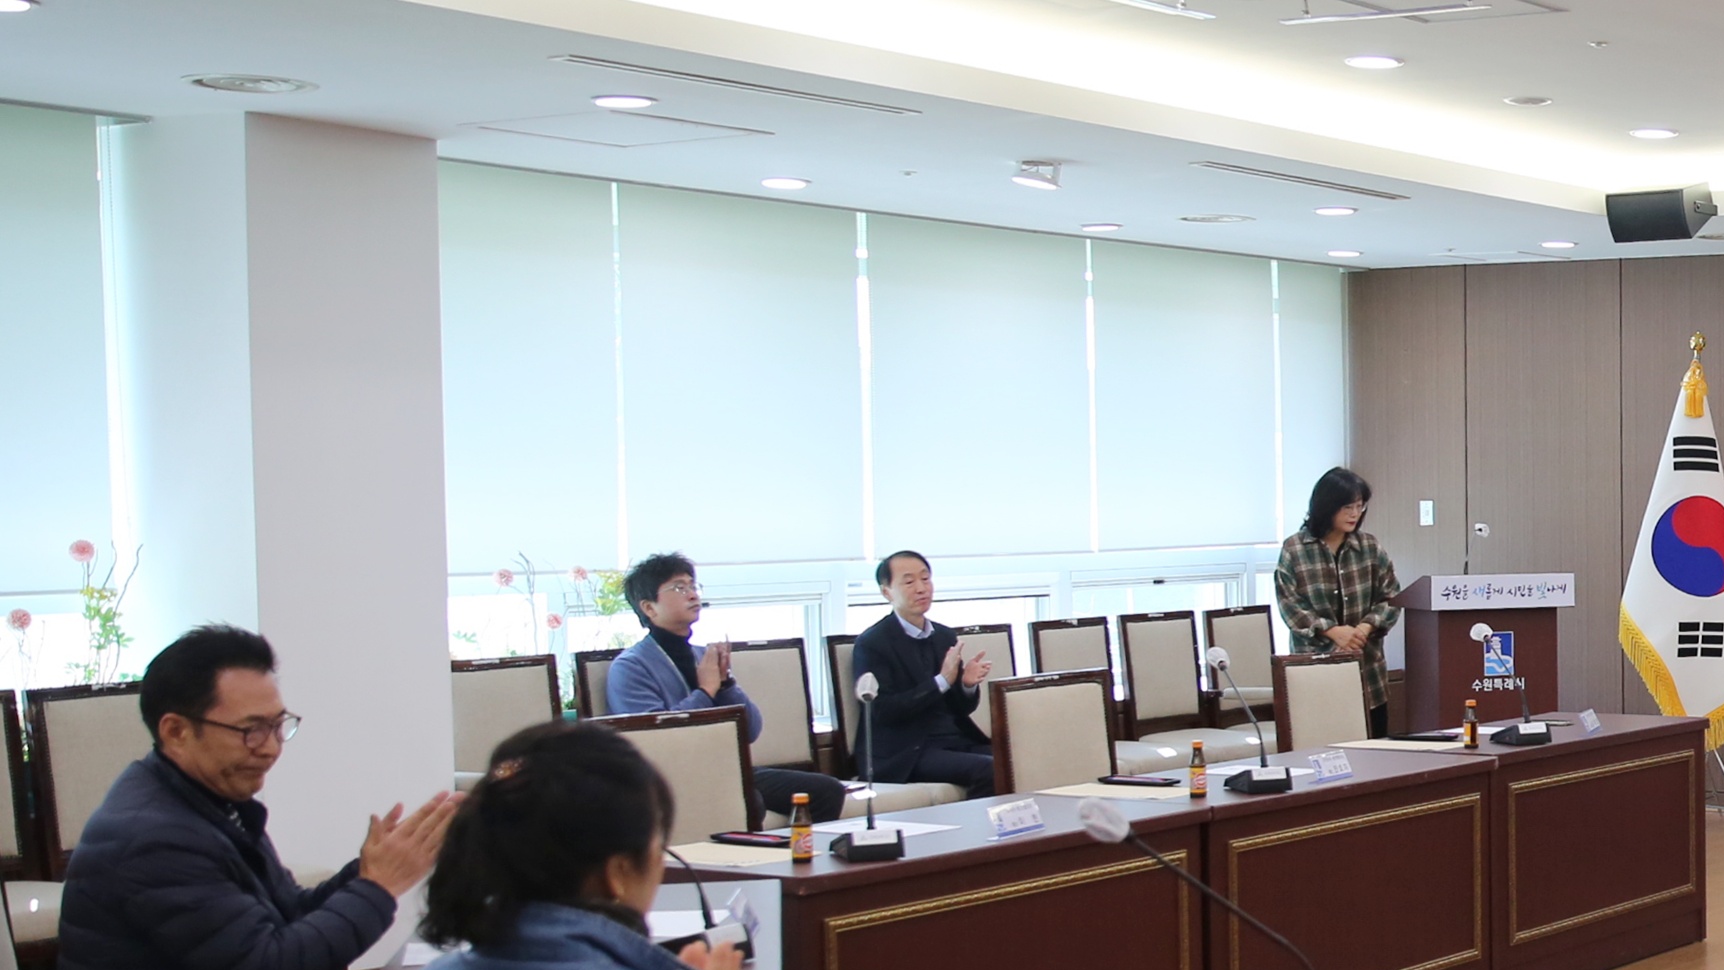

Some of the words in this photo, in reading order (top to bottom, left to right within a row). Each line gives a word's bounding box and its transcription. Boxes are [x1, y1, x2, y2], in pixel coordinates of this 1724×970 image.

[1441, 584, 1469, 601] 수원을
[1472, 583, 1504, 600] 새롭게
[1507, 585, 1534, 598] 시민을
[1536, 581, 1567, 600] 빛나게
[1471, 677, 1525, 692] 수원특례시
